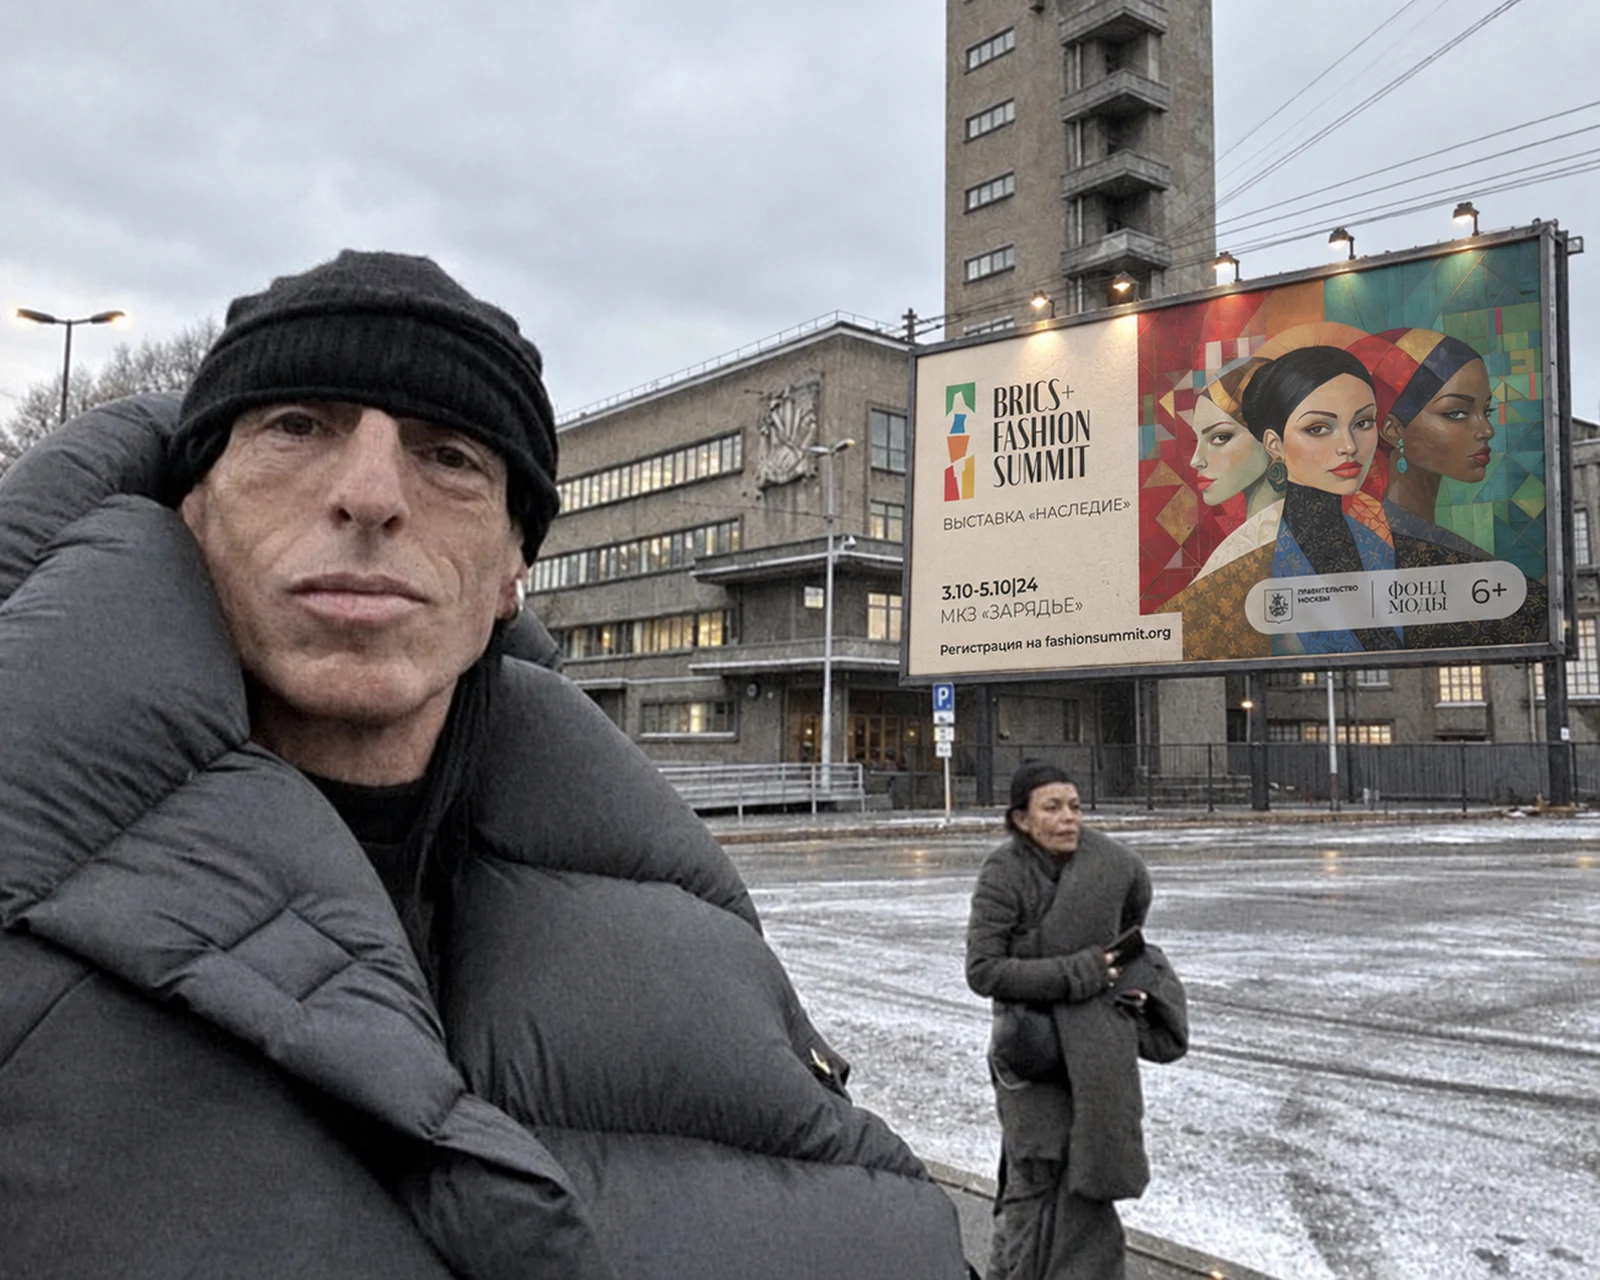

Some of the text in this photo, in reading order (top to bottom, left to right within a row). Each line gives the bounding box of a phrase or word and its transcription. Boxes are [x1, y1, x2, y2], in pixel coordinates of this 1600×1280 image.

[993, 378, 1075, 419] BRICS+
[993, 409, 1091, 452] FASHION
[993, 444, 1090, 488] SUMMIT
[943, 497, 1131, 531] ВЫСТАВКА «НАСЛЕДИЕ»
[1388, 580, 1447, 601] ФОНД
[1471, 579, 1508, 604] 6+
[940, 596, 1083, 624] МКЗ «ЗАРЯДЬЕ»
[1388, 597, 1448, 615] МОДЫ
[940, 626, 1172, 656] Регистрация на fashionsummit.org
